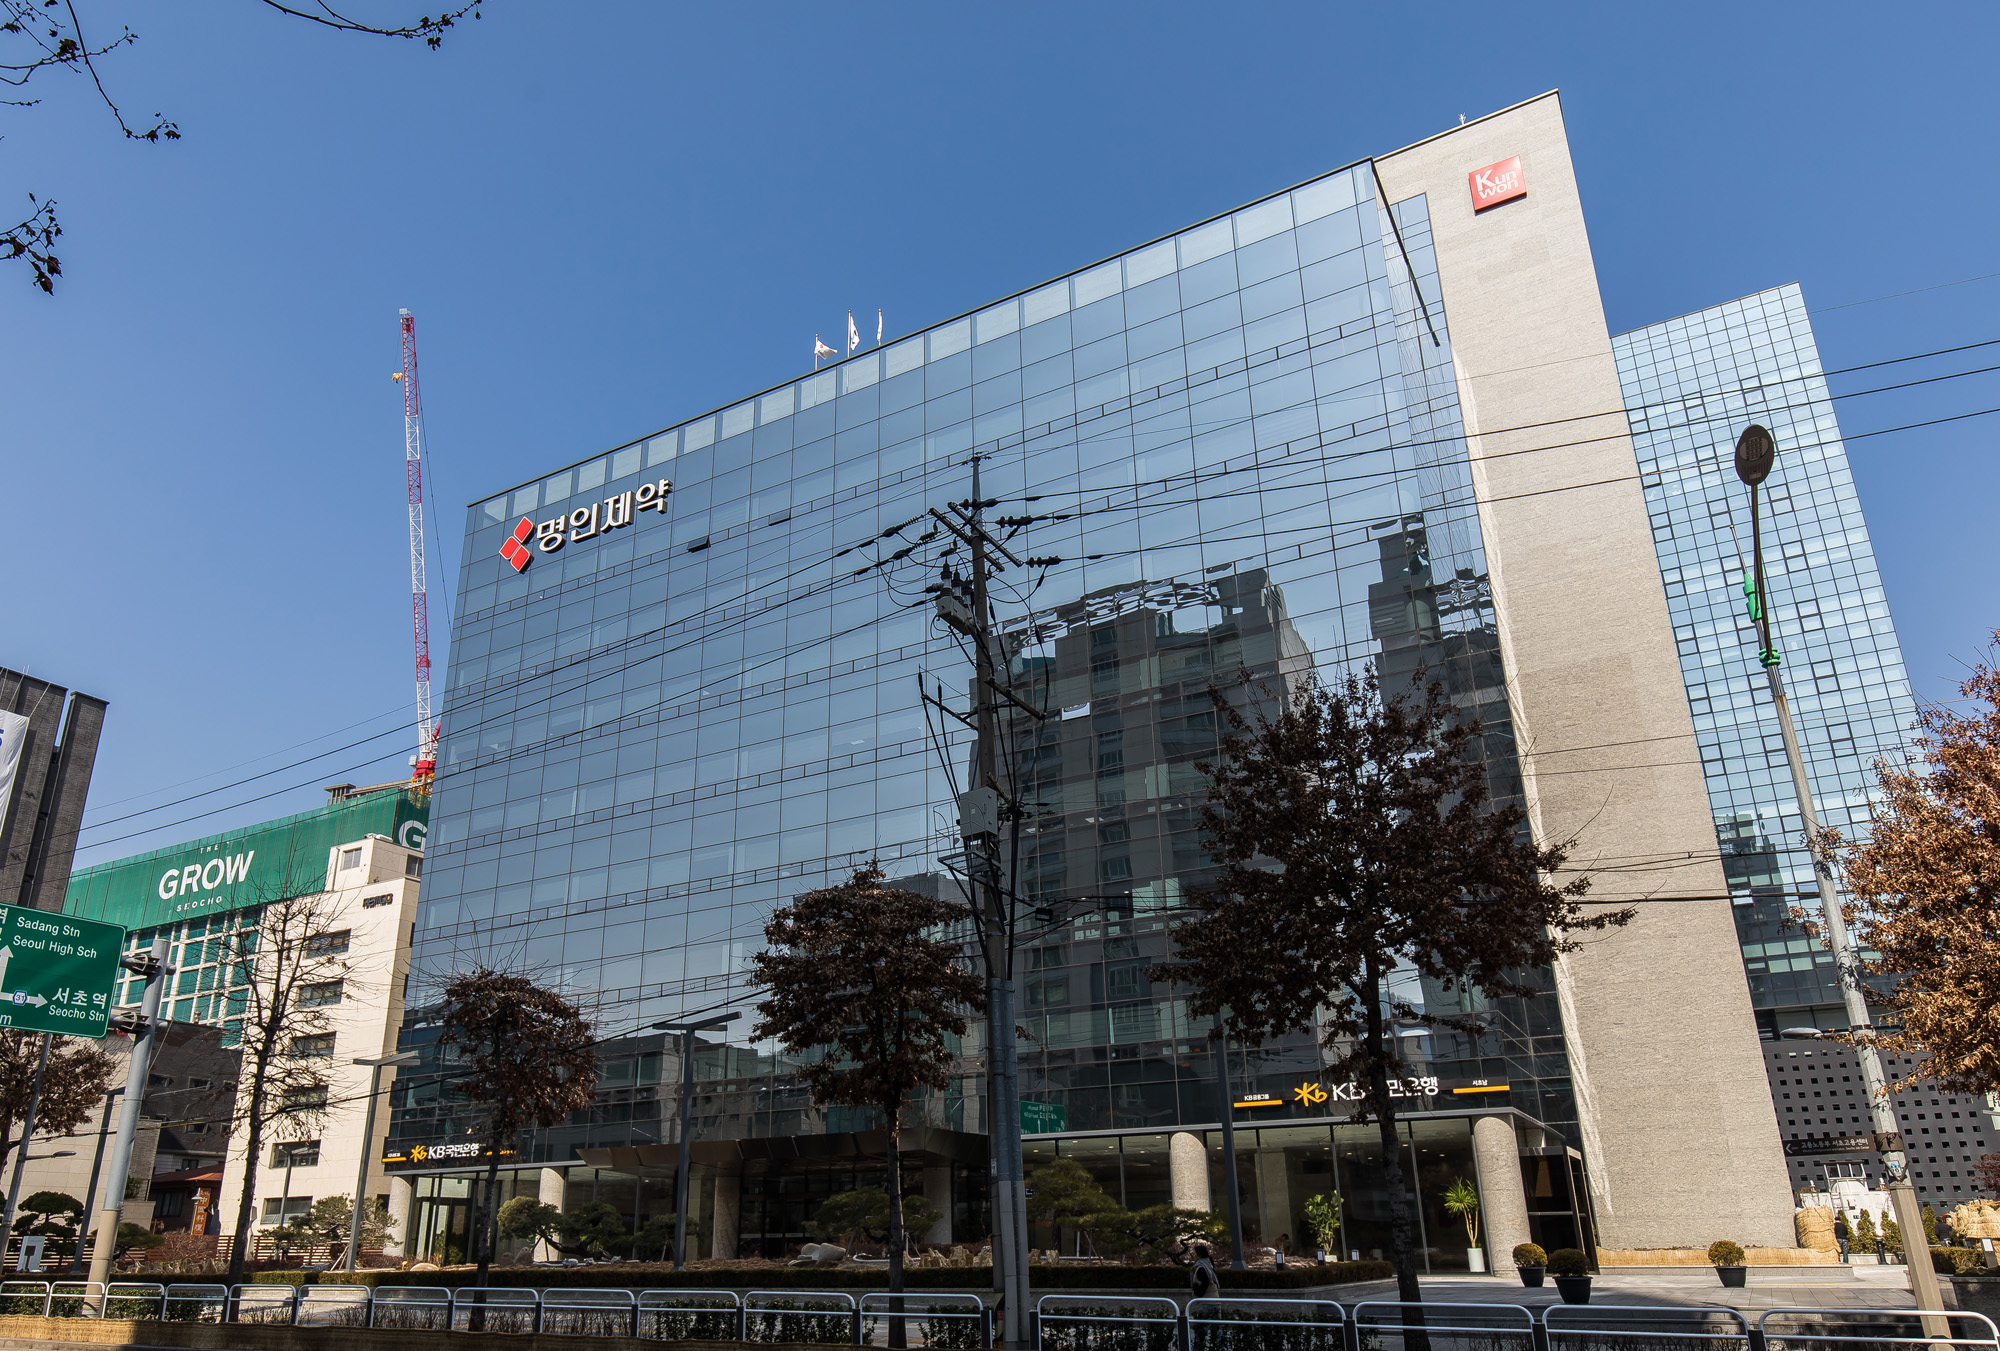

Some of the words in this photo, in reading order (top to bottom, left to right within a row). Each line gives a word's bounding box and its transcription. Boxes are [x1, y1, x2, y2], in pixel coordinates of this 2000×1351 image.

[1475, 168, 1517, 192] Kun
[1478, 180, 1519, 199] won
[536, 478, 673, 553] 명인제약
[158, 850, 255, 900] GROW
[176, 896, 223, 912] SEOCHO
[16, 916, 59, 936] Sadang
[62, 925, 81, 937] Stn
[13, 935, 45, 950] Seoul
[49, 942, 74, 956] High
[77, 946, 97, 958] Sch
[52, 987, 107, 1009] 서초역
[49, 1005, 86, 1019] Seocho
[89, 1010, 105, 1022] Stn
[1332, 1076, 1439, 1101] KB민은행
[1801, 1141, 1831, 1149] 고용노동부
[1832, 1138, 1869, 1147] 서초고용센터
